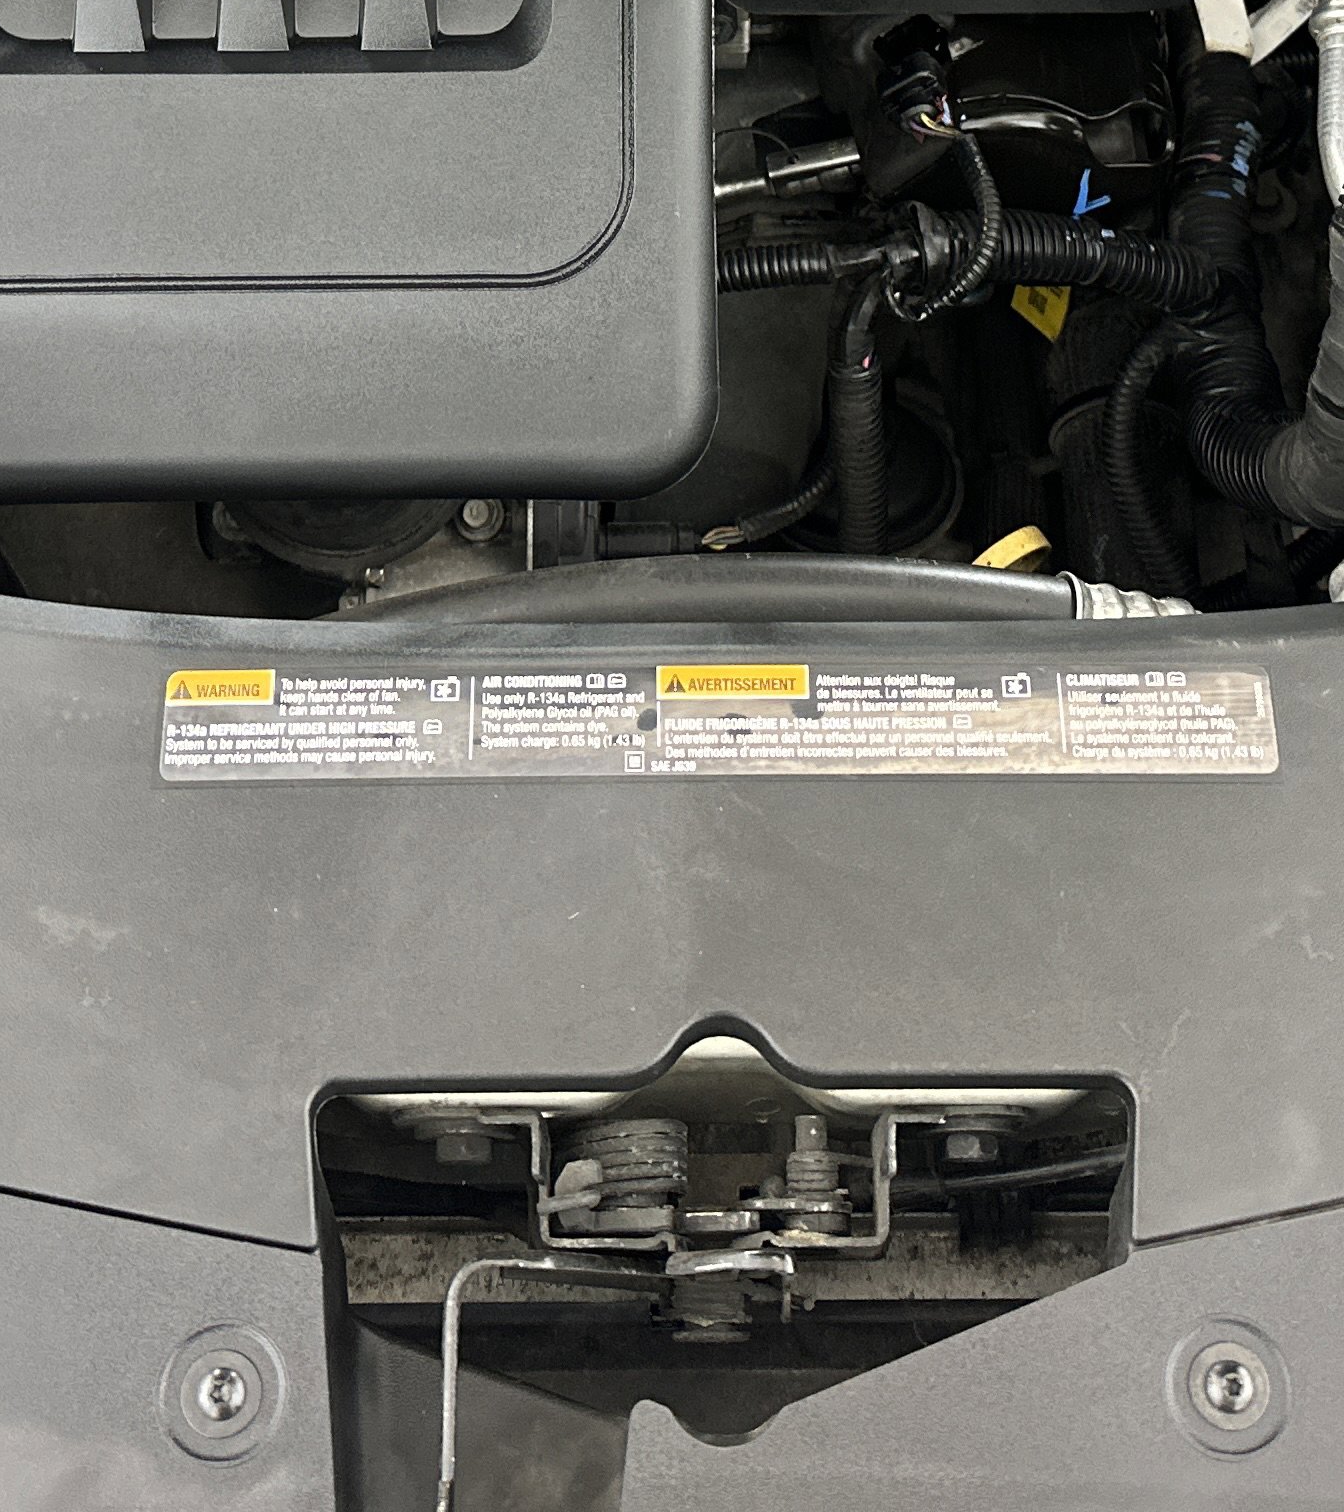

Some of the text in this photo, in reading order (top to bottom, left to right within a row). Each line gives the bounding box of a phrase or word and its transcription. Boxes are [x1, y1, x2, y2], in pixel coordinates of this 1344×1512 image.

[280, 678, 293, 690] To
[296, 678, 317, 692] help
[320, 677, 348, 689] avoid
[350, 677, 393, 691] personal
[482, 675, 583, 688] AIR CONDITIONING
[687, 677, 797, 691] AVERTISSEMENT
[816, 674, 955, 688] Attention aux doigts! Risque
[1066, 673, 1139, 686] CLIMATISEUR
[196, 683, 261, 698] WARNING
[279, 690, 400, 704] keep hands clear of fan.
[816, 687, 993, 701] de blessures. Le ventilateur peut se
[1067, 690, 1201, 703] Utiliser seulement le fluide
[482, 691, 645, 706] Use only R-134a Refrigerant and
[817, 699, 1002, 711] mettre à tourner sans avertissement.
[279, 703, 396, 718] It can start at any time.
[481, 705, 640, 720] Polyalkylene Glycol oil (PAG oil).
[1069, 704, 1226, 718] frigorigène R-134a et de l'huile
[166, 720, 416, 737] R-134a REFRIGERANT UNDER HIGH PRESSURE
[481, 719, 609, 735] The system contains dye.
[665, 718, 704, 730] FLUIDE
[780, 717, 819, 730] R-134a
[822, 717, 851, 729] SOUS
[853, 717, 890, 729] HAUTE
[891, 716, 947, 728] PRESSION
[166, 735, 419, 752] System to be serviced by qualified personnel only.
[481, 734, 646, 749] System charge: 0.65 kg (1.43 lb)
[165, 749, 436, 767] Improper service methods may cause personal injury.
[666, 745, 1008, 759] Des méthodes d'entretien incorrectes peuvent causer des blessures.
[651, 760, 670, 772] SAE
